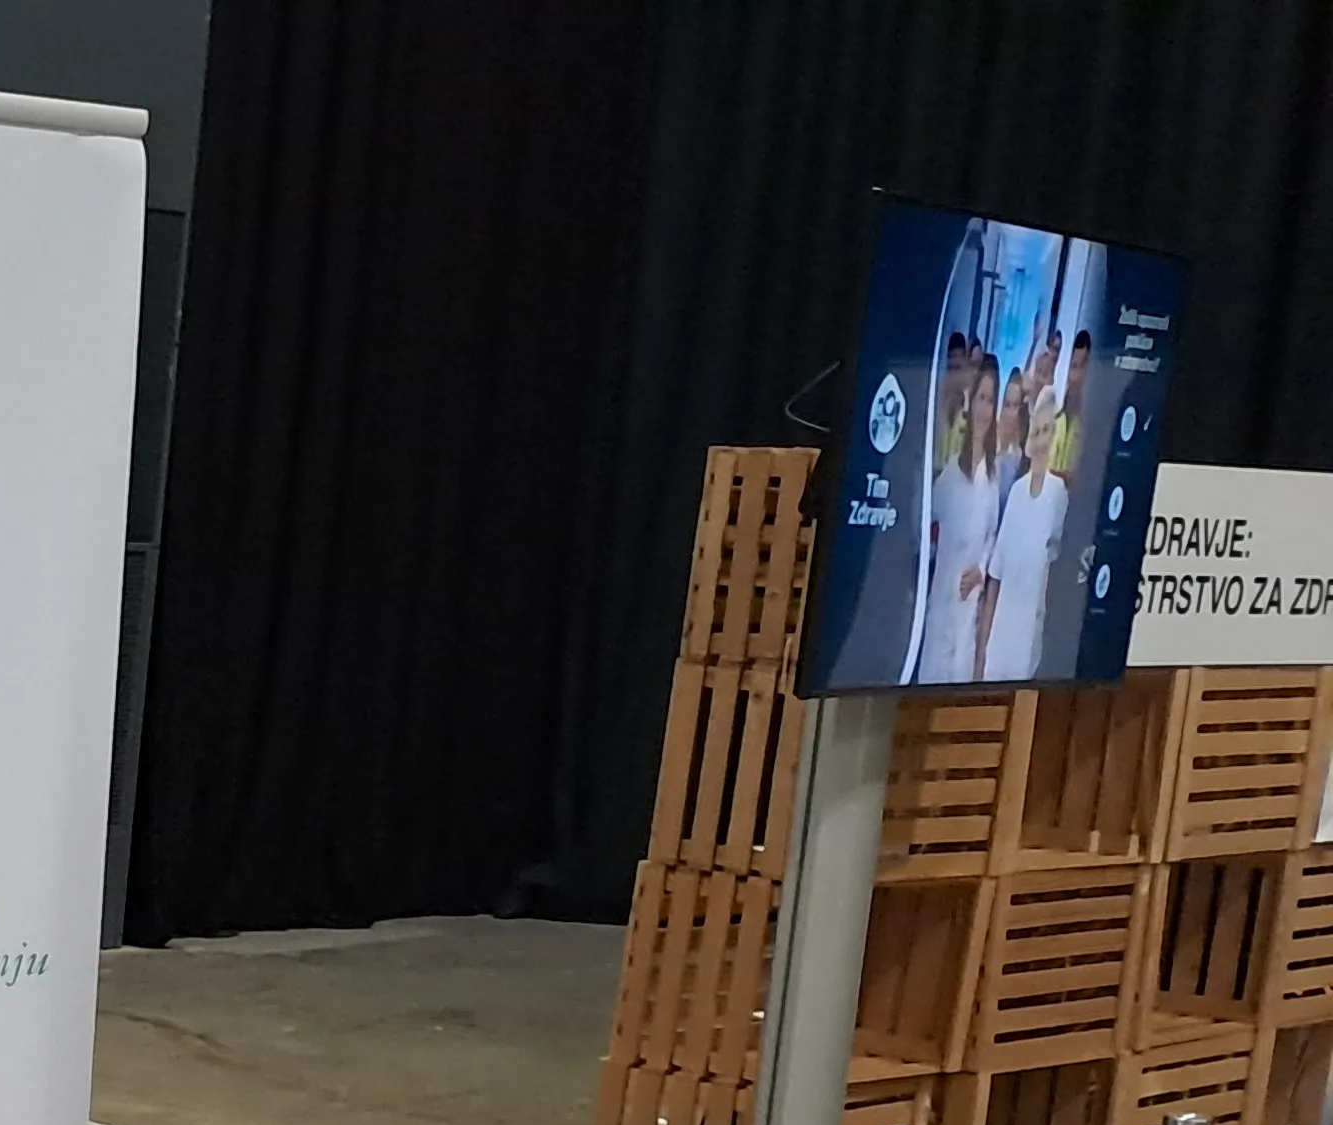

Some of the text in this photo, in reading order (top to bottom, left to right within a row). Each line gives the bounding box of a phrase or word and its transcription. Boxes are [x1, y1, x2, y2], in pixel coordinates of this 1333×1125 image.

[1148, 516, 1253, 558] DRAVJE:
[1134, 575, 1244, 616] STRSTVO
[1248, 577, 1282, 615] ZA
